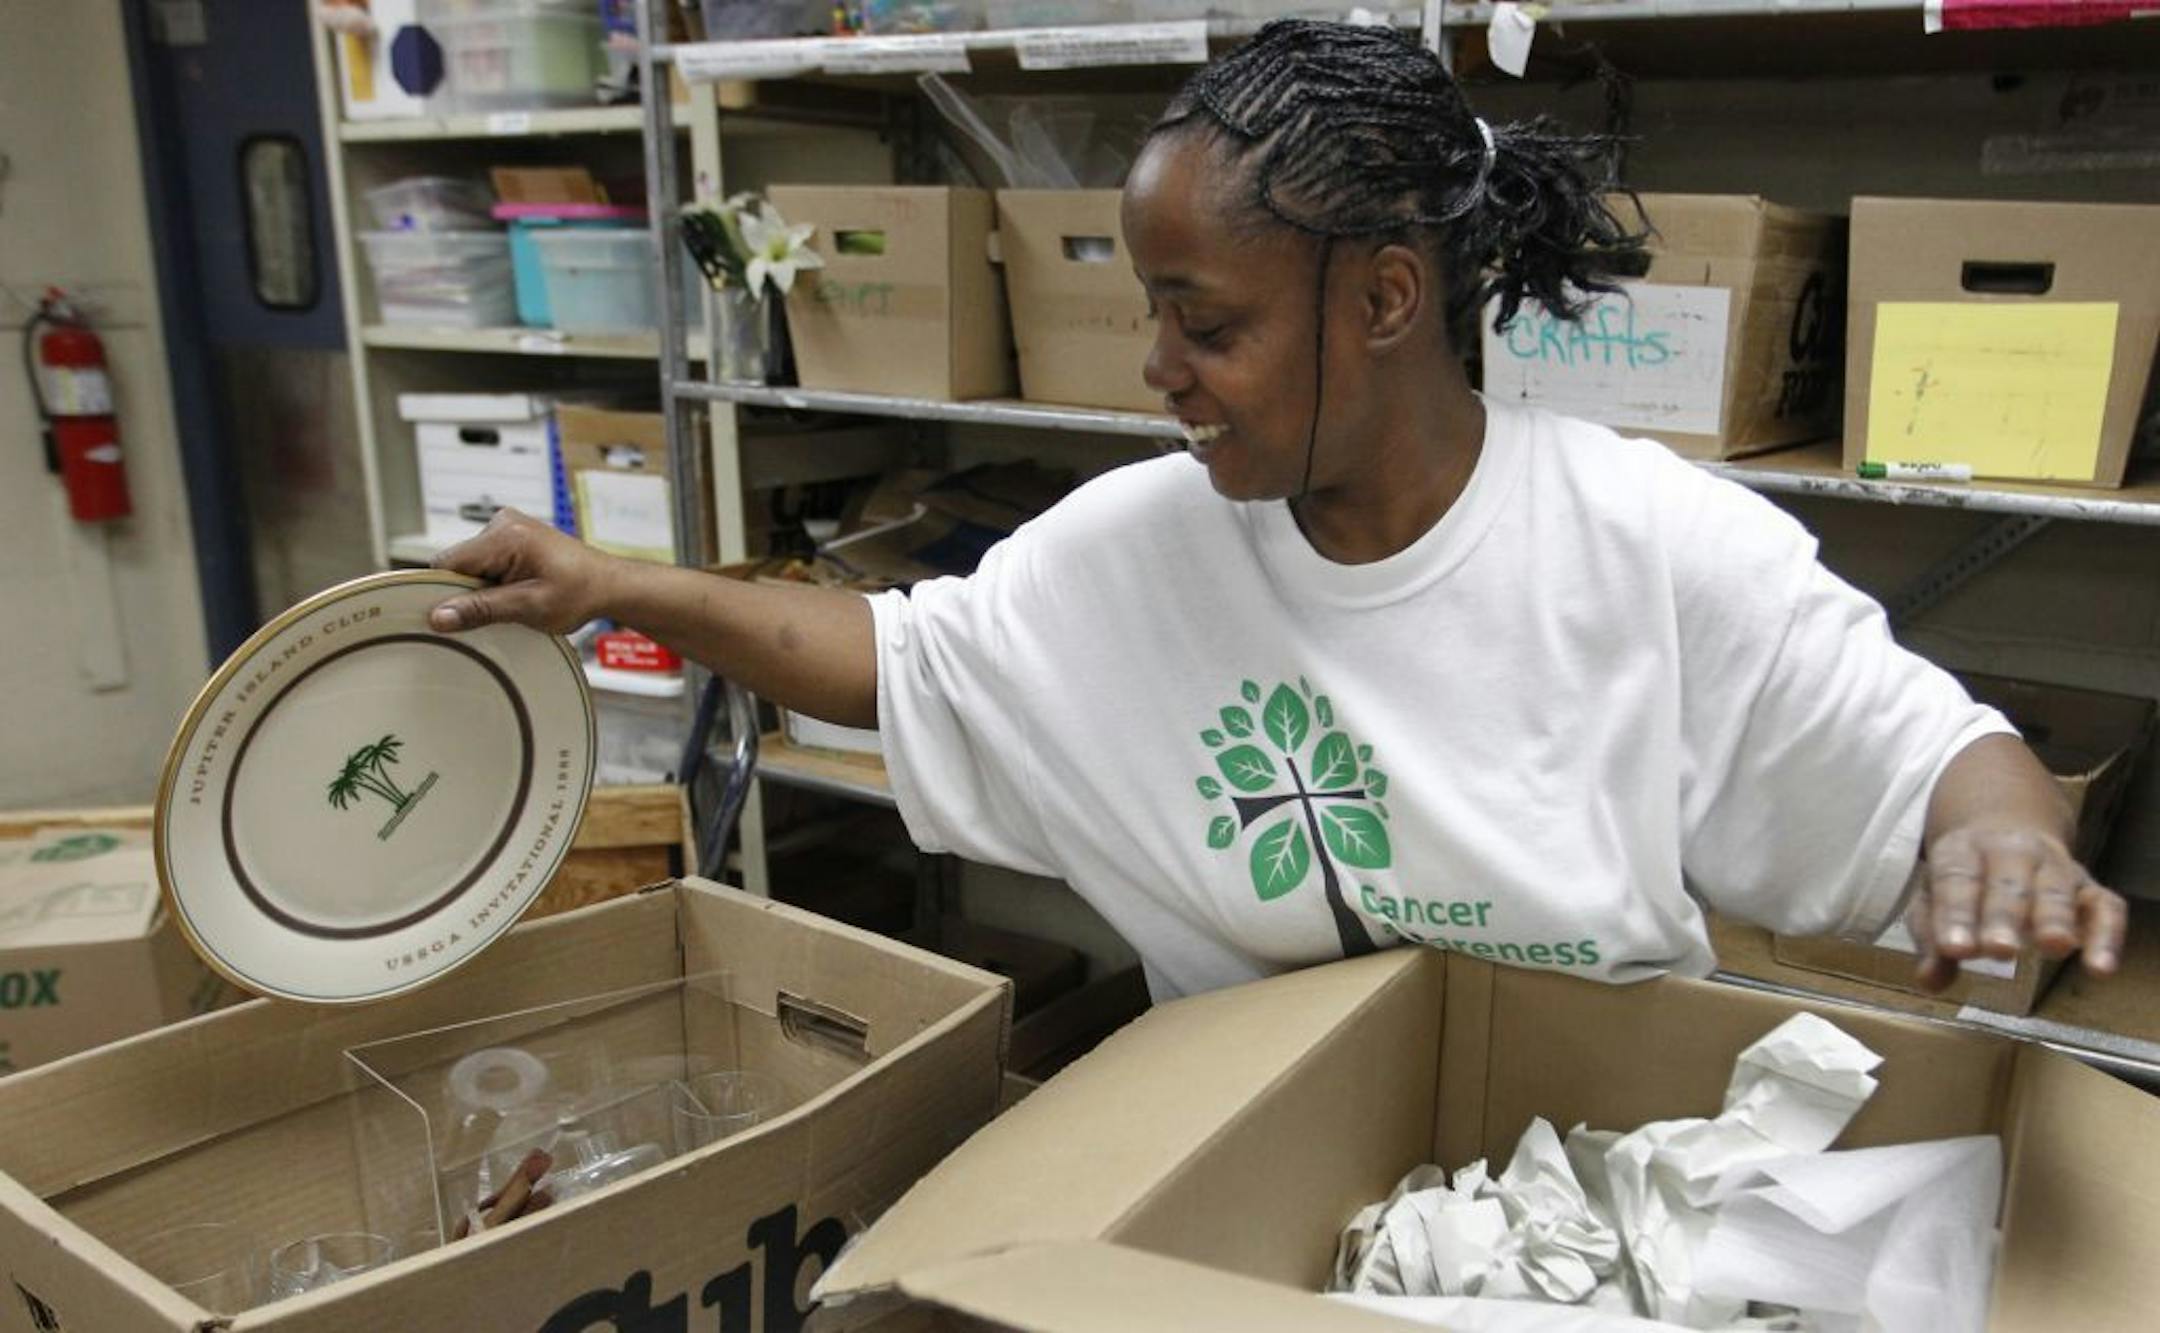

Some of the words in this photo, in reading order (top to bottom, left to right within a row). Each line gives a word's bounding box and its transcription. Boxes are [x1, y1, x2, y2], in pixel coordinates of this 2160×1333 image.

[190, 709, 236, 805] JUPITER
[237, 635, 314, 703] ISLAND
[322, 606, 382, 635] CLUB
[468, 801, 565, 929] INVITATIONAL
[1361, 884, 1492, 927] Cancer
